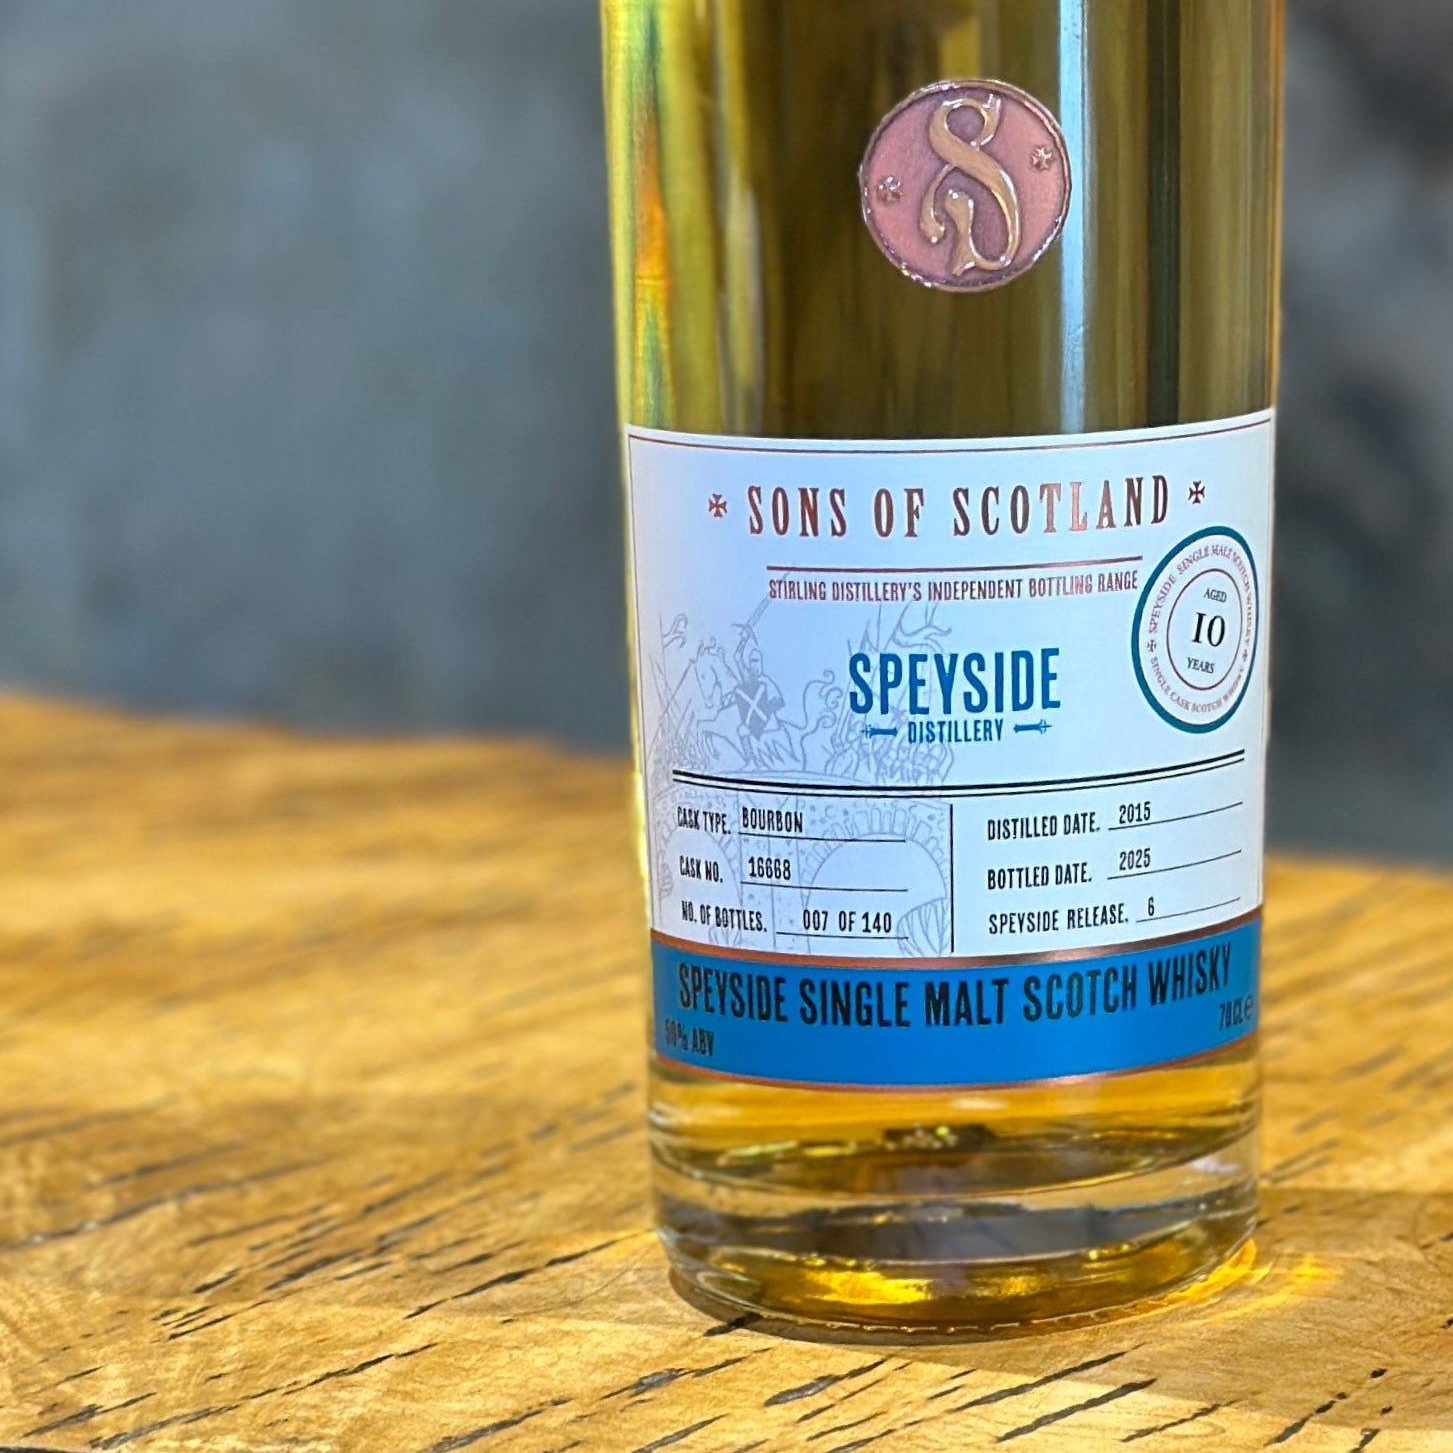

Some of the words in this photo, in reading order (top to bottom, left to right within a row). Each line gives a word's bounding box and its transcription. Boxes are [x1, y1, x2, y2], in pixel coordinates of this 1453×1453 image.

[748, 484, 846, 538] SONS
[873, 487, 925, 539] OF
[952, 474, 1170, 537] SCOTLAND
[768, 578, 827, 601] STIRLING
[832, 580, 922, 602] DISTILLERY'S
[927, 578, 1023, 601] INDEPENDENT
[1028, 574, 1093, 598] BOTTLING
[1098, 570, 1139, 593] RANGE
[1149, 574, 1177, 634] SPEYSIDE
[1177, 545, 1209, 576] SINGLE
[1203, 588, 1227, 604] AGED
[1191, 612, 1226, 648] 10
[849, 647, 1062, 715] SPEYSIDE
[1151, 656, 1171, 695] SINGLE
[1170, 691, 1190, 711] CASK
[1187, 657, 1216, 674] YEARS
[907, 719, 1003, 744] DISTILLERY
[677, 806, 699, 832] CASK
[703, 808, 731, 835] TYPE.
[742, 806, 803, 834] BOURBON
[987, 815, 1058, 841] DISTILLED
[1063, 811, 1101, 834] DATE.
[1119, 801, 1151, 824] 2015
[679, 855, 701, 880] CASK
[705, 860, 723, 883] NO.
[748, 856, 791, 880] 16668
[987, 865, 1049, 891] BOTTLED
[1055, 862, 1092, 885] DATE.
[1119, 847, 1151, 871] 2025
[681, 900, 697, 923] NO.
[699, 903, 711, 926] OF
[715, 906, 767, 933] BOTTLES.
[802, 908, 829, 932] 007
[838, 910, 856, 932] OF
[861, 911, 892, 934] 140
[988, 909, 1059, 935] SPEYSIDE
[1067, 902, 1128, 930] RELEASE.
[1147, 896, 1155, 917] 6
[678, 961, 789, 1023] SPEYSIDE
[800, 978, 911, 1030] SINGLE
[924, 977, 1010, 1028] MALT
[1023, 963, 1137, 1023] SCOTCH
[1147, 941, 1231, 1006] WHISKY
[692, 1027, 715, 1057] ABV
